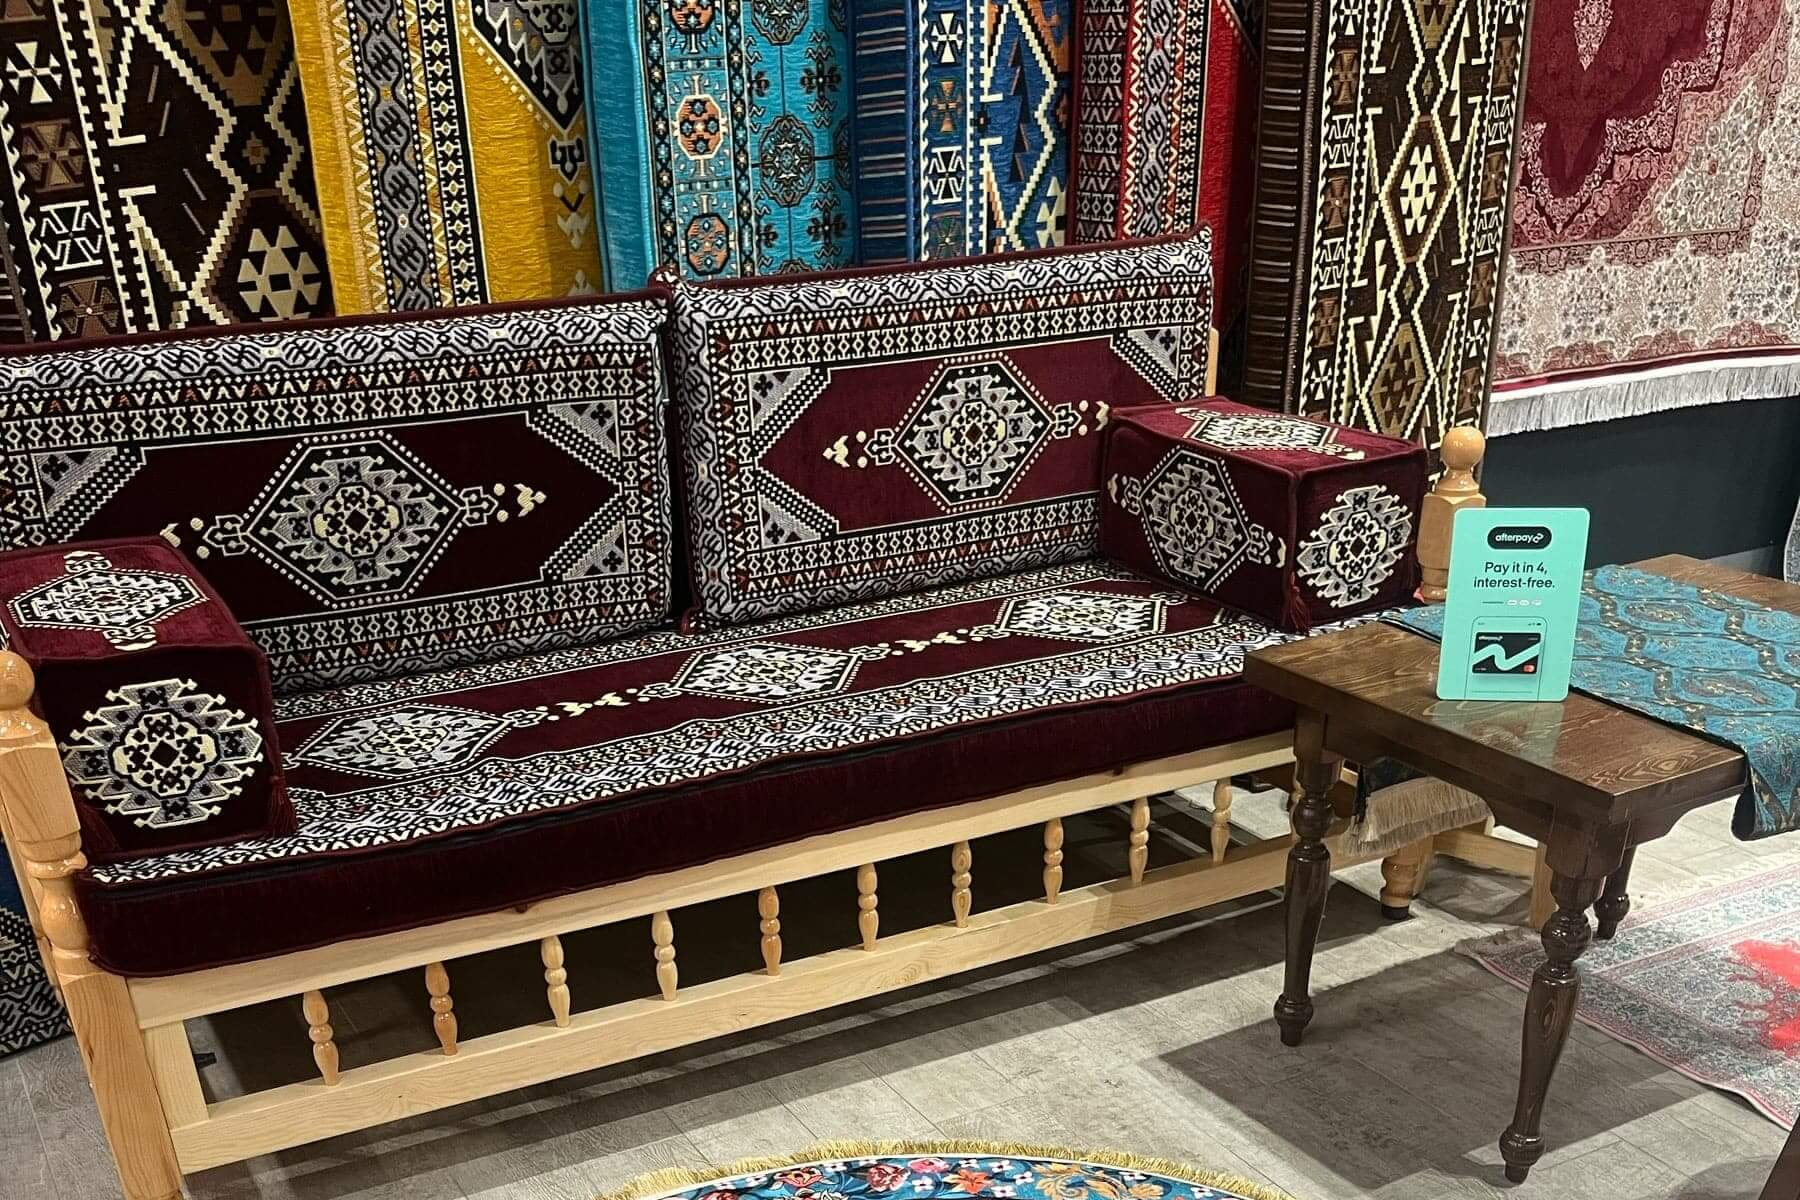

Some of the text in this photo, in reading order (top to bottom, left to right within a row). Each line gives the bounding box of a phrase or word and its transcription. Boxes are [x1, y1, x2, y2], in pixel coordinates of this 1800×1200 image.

[1494, 533, 1534, 543] afterpay
[1484, 561, 1548, 575] Pay it in 4,
[1473, 576, 1555, 588] interest-free.
